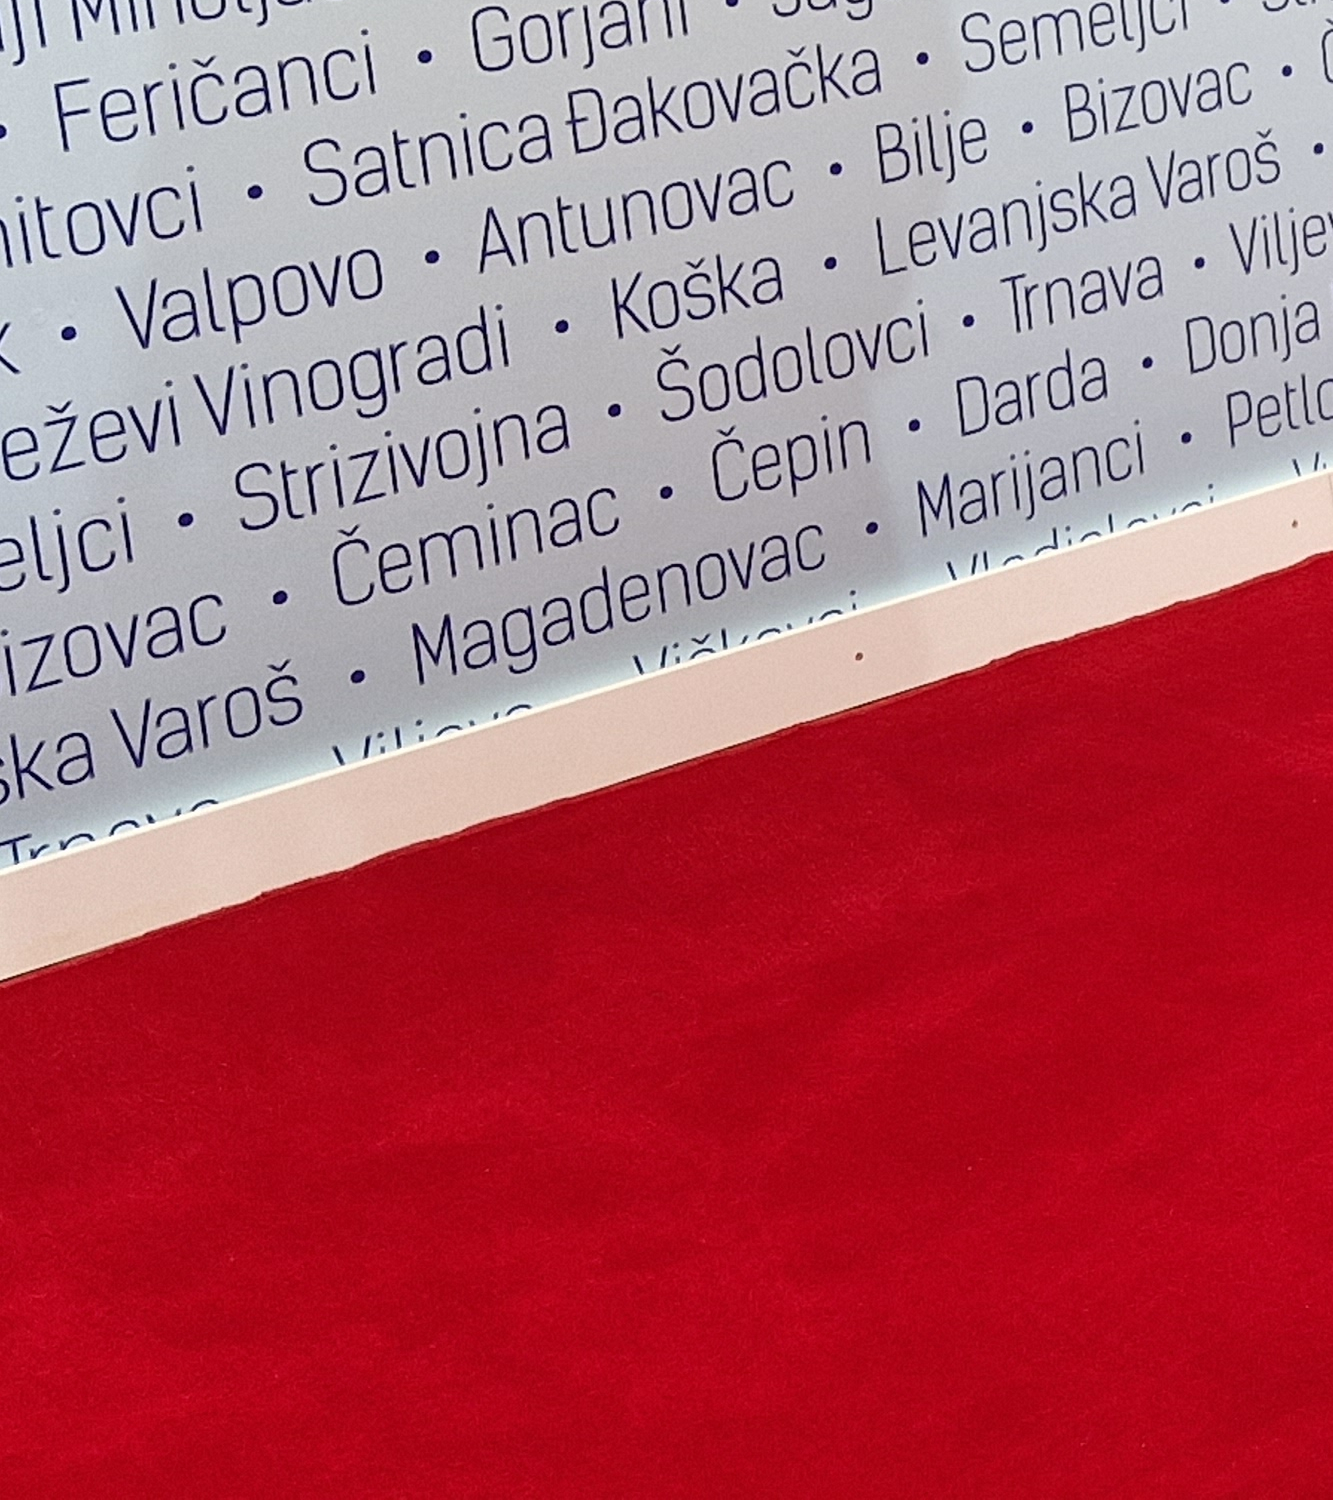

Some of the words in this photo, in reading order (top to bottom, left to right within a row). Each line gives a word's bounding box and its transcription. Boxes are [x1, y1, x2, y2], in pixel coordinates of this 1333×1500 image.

[54, 29, 376, 152] Feričanci
[115, 249, 383, 349] Valpovo
[479, 160, 794, 274] Antunovac
[876, 110, 987, 184] Bilje
[1064, 62, 1252, 143] Bizovac
[304, 113, 552, 206] Satnica
[565, 43, 881, 154] Đakovačka
[193, 304, 509, 436] Vinogradi
[611, 254, 785, 340] Koška
[876, 171, 1137, 276] Levanjska
[1146, 128, 1281, 211] Varoš
[235, 405, 570, 530] Strizivojna
[657, 299, 929, 422] Šodolovci
[1000, 256, 1164, 333] Trnava
[333, 488, 619, 606] Čeminac
[712, 415, 871, 501] Čepin
[956, 348, 1108, 437] Darda
[1186, 294, 1320, 375] Donja
[110, 659, 303, 769] Varoš
[412, 525, 825, 685] Magadenovac
[917, 419, 1144, 538] Marijanci
